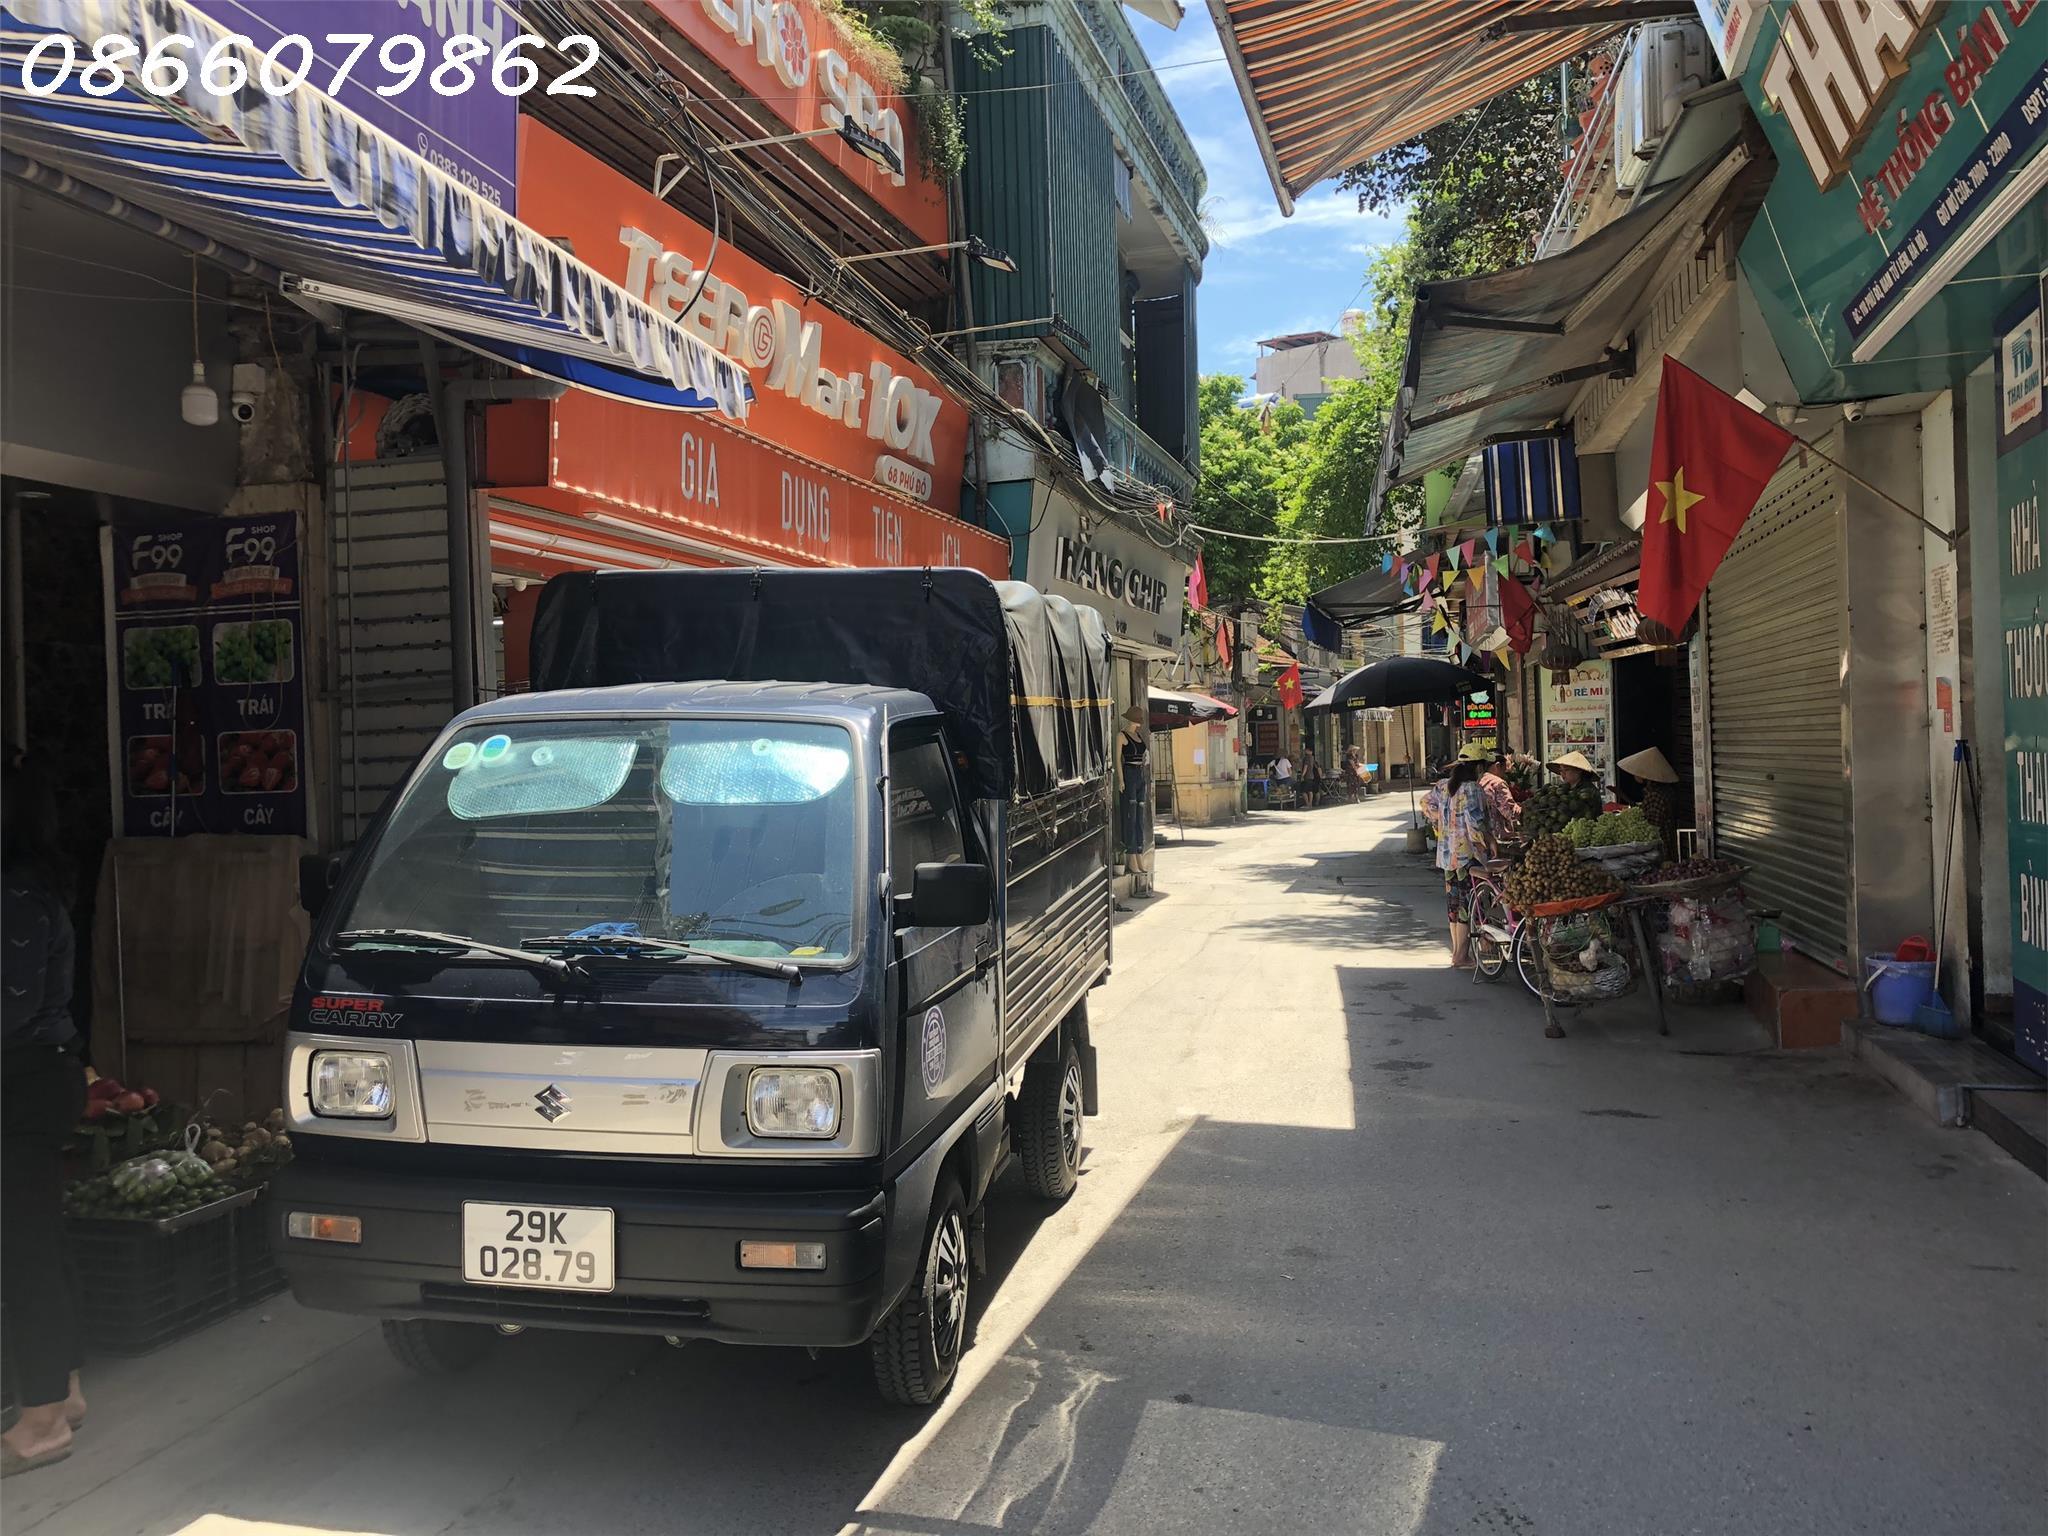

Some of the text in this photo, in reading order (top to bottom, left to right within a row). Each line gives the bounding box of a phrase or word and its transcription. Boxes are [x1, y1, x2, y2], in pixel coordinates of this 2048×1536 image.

[1876, 91, 1956, 202] THỐNG
[1944, 6, 2011, 108] BÁN
[429, 149, 502, 206] 0383 129 525
[765, 298, 867, 430] Mart
[680, 431, 721, 508] GIA
[781, 470, 831, 546] DỤNG
[887, 466, 898, 484] 68
[900, 471, 915, 491] PHÚ
[157, 532, 184, 542] SHOP
[224, 527, 277, 563] F99
[250, 525, 277, 534] SHOP
[2010, 479, 2041, 577] NHÀ
[131, 535, 184, 571] F99
[236, 694, 275, 715] TRÁI
[243, 803, 275, 826] CÂY
[308, 1009, 404, 1029] CARRY
[311, 996, 384, 1012] SUPER
[505, 1209, 567, 1245] 29K
[479, 1246, 596, 1285] 028.79
